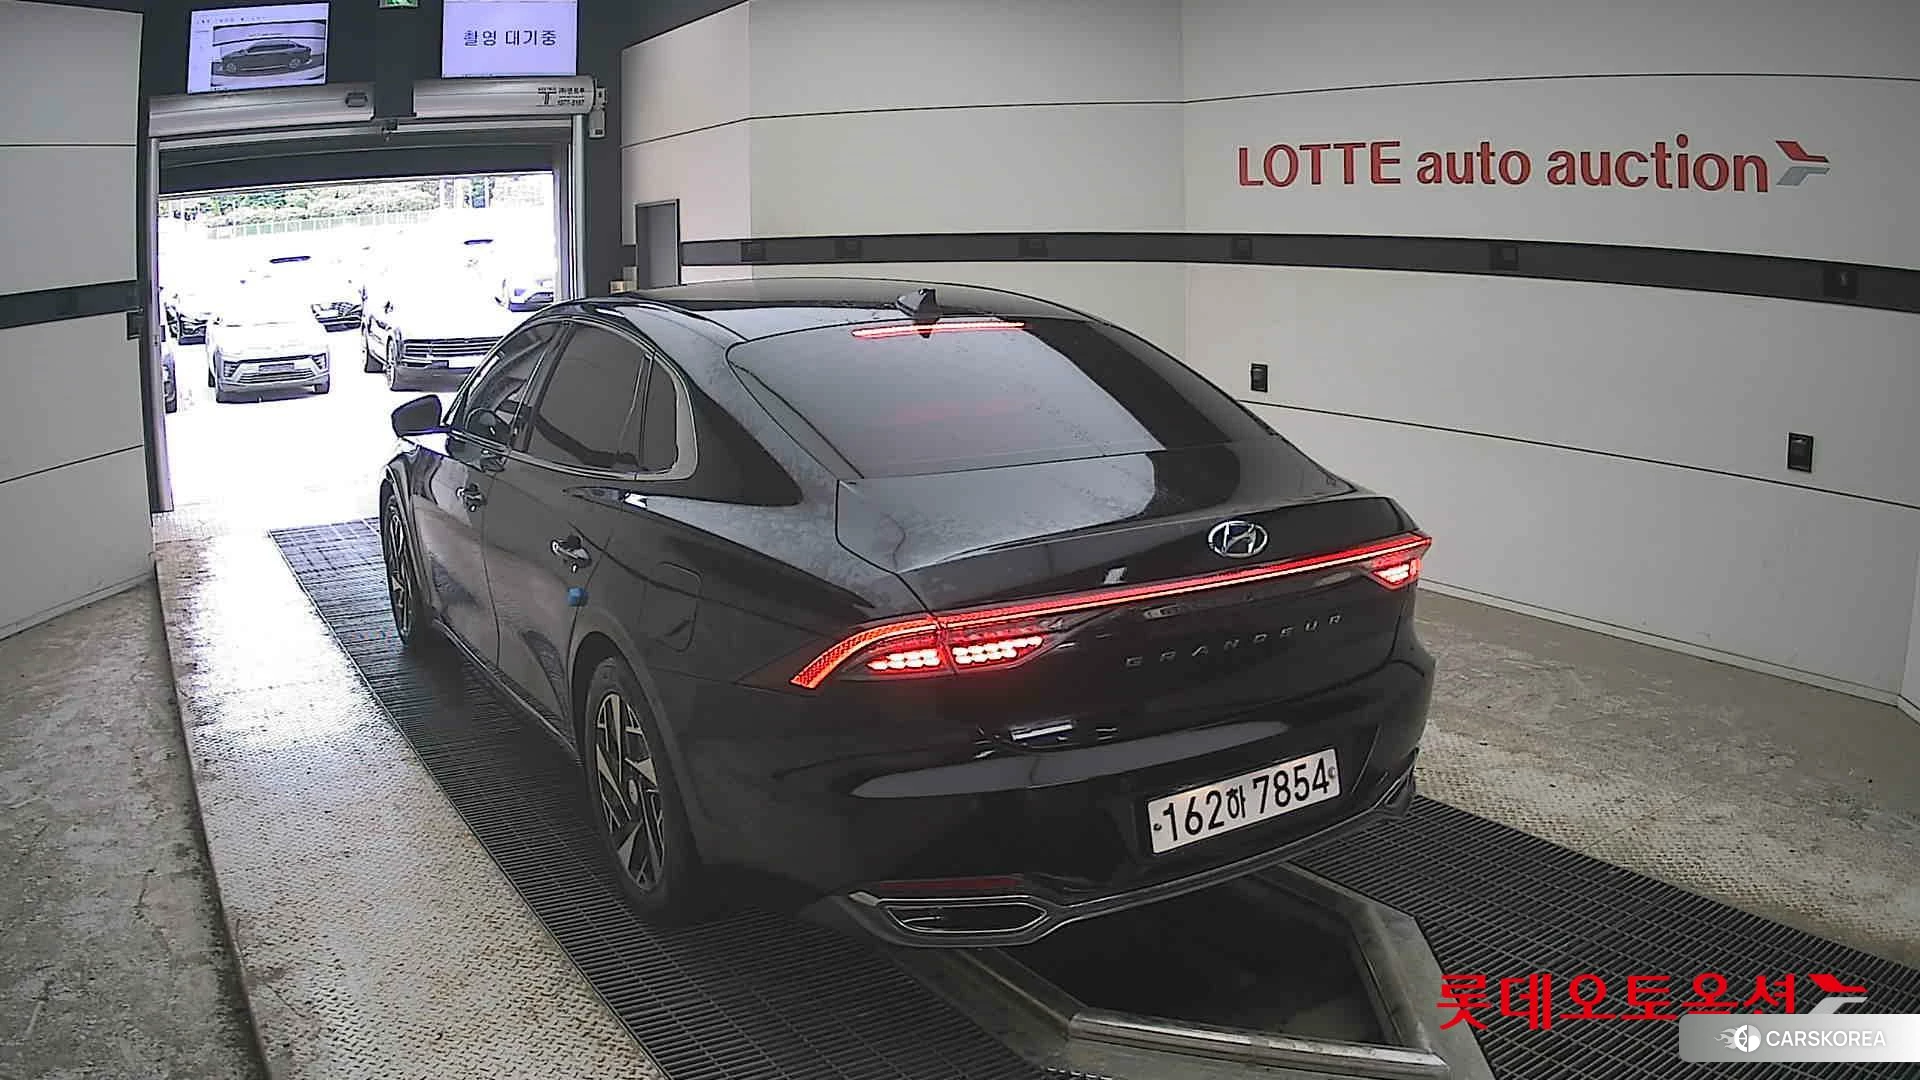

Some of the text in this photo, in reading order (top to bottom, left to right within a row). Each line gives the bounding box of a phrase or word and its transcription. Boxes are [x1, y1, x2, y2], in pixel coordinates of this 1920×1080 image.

[505, 29, 557, 46] 대기중
[1238, 133, 1769, 193] LOTTE auto auction
[1125, 614, 1342, 667] GRANDEUR
[1252, 757, 1330, 814] 7854
